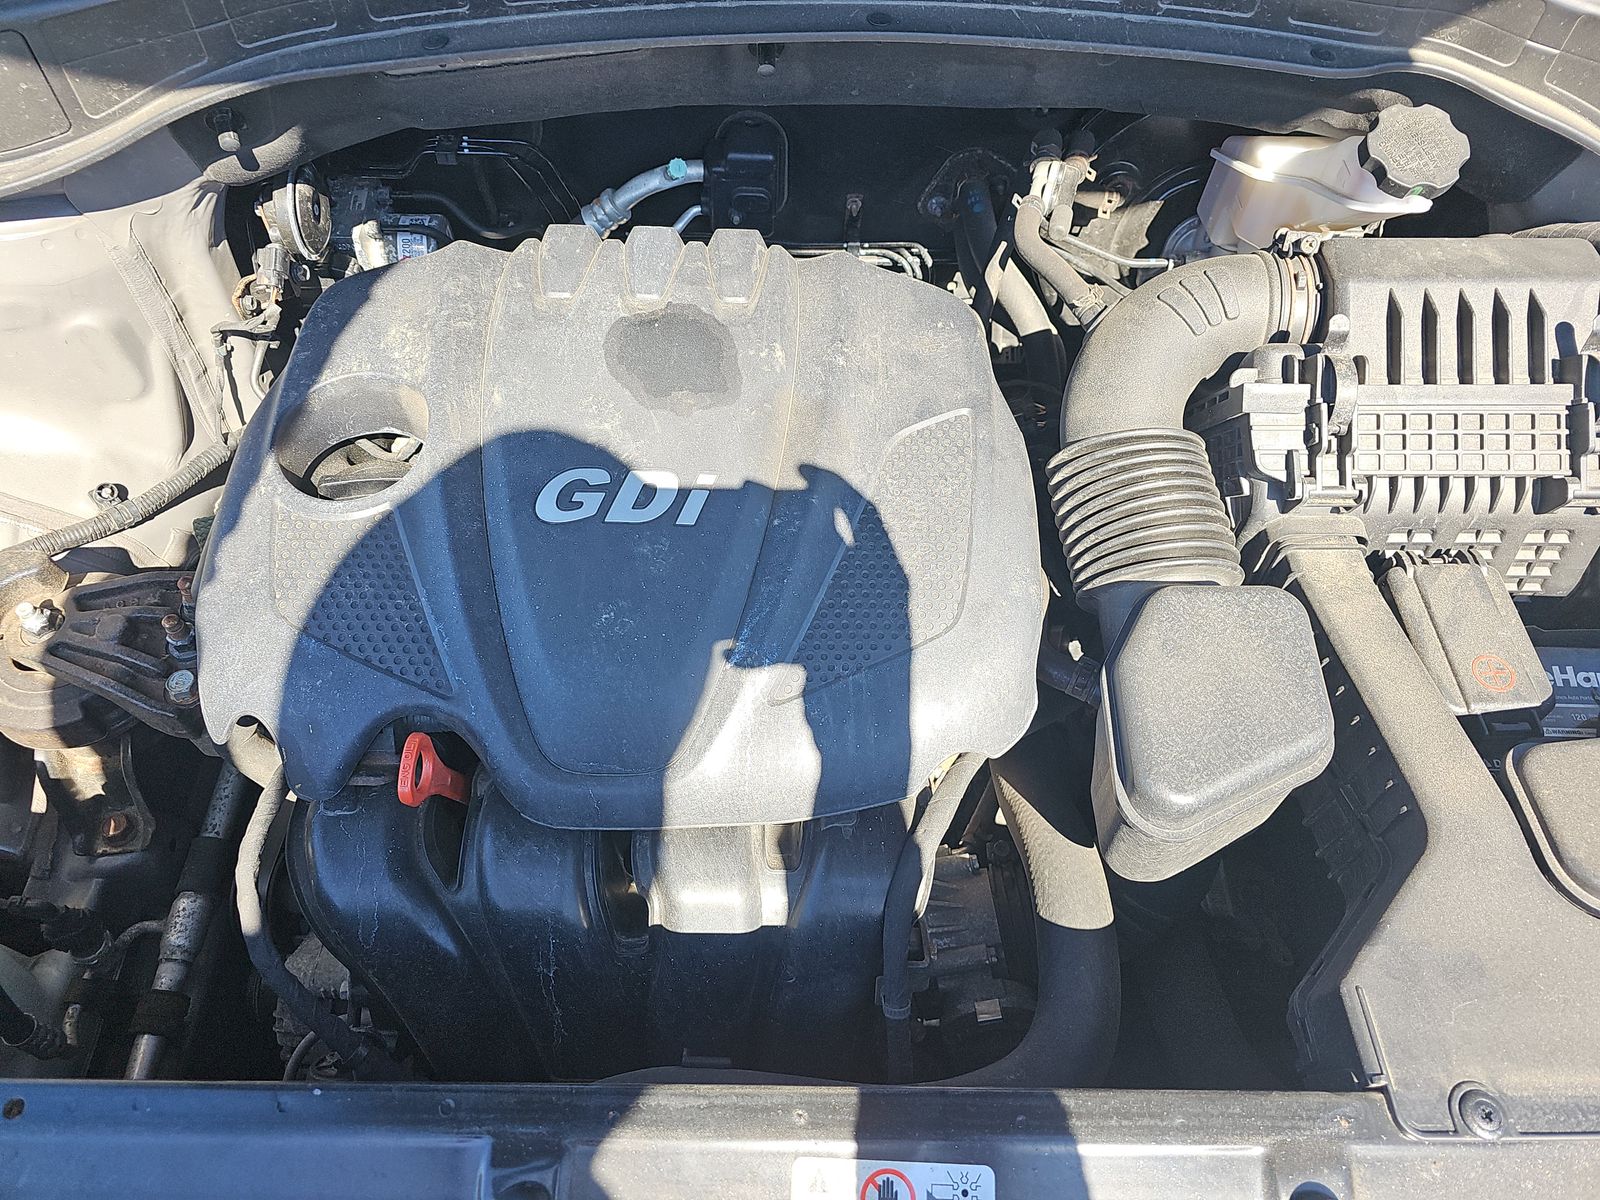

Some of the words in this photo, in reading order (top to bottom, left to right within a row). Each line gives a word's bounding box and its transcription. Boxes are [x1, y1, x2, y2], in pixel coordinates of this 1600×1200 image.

[535, 468, 719, 525] GDi
[400, 763, 410, 787] ENG
[405, 741, 417, 760] OIL
